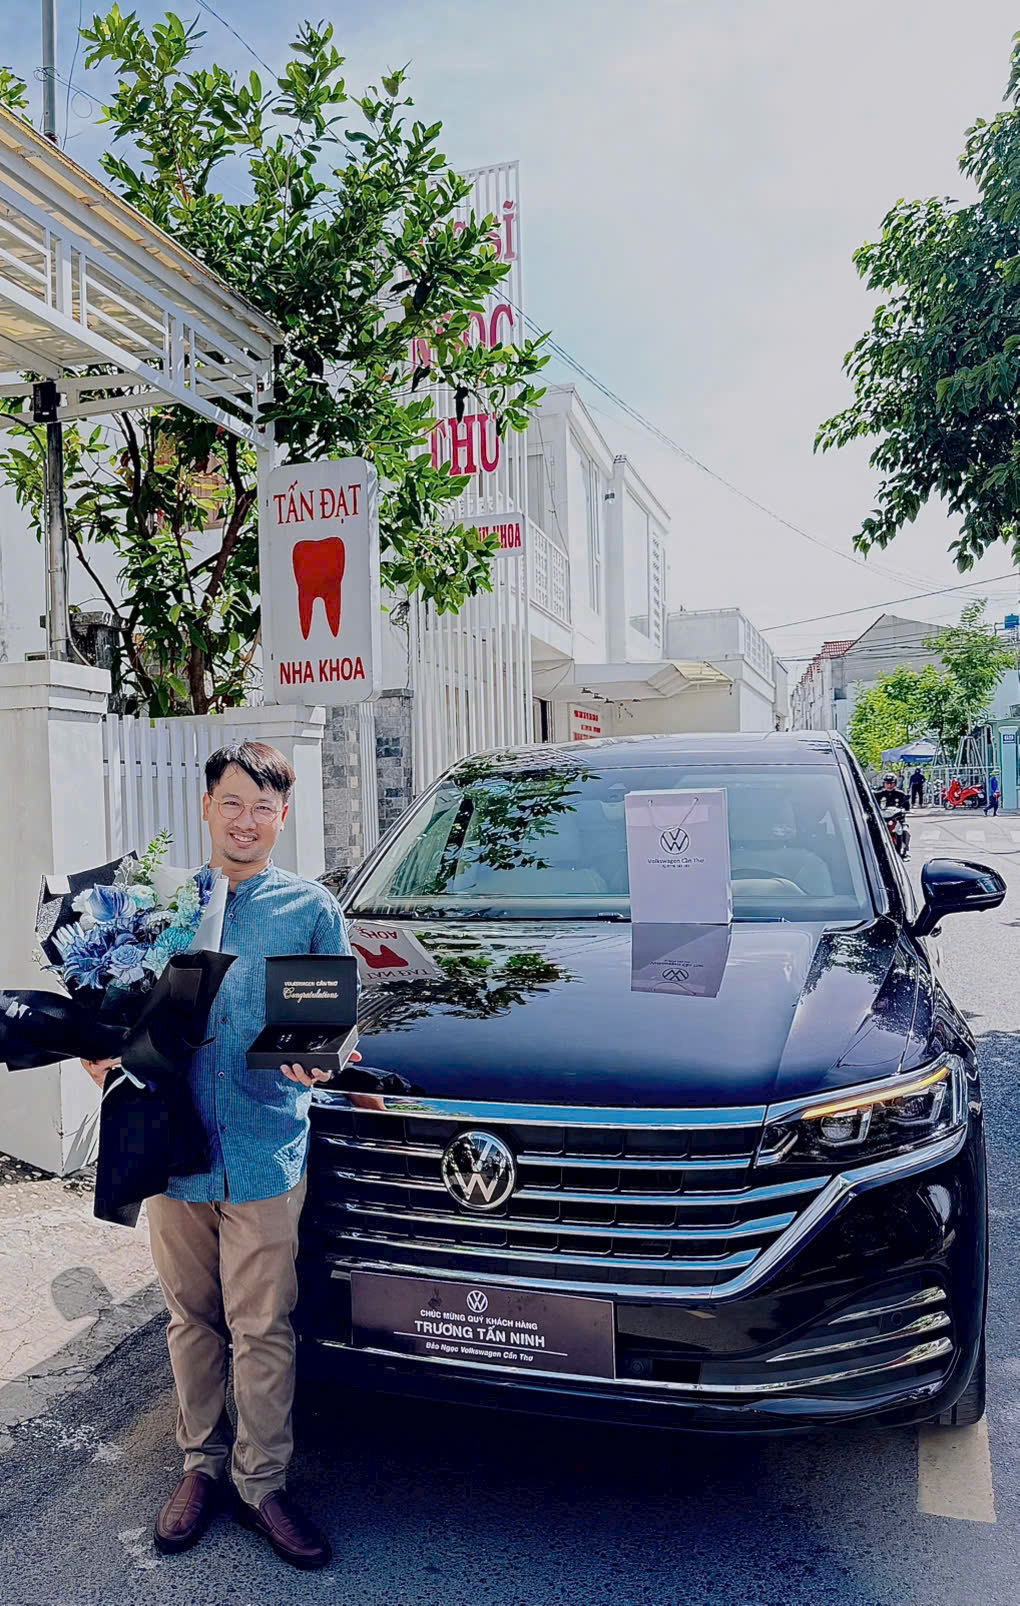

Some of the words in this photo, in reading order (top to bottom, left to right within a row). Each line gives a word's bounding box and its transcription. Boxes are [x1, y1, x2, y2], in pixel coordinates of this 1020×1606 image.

[273, 480, 314, 524] TẤN
[320, 484, 361, 524] ĐẠT
[279, 661, 315, 685] NHA
[318, 656, 366, 682] KHOA
[283, 986, 339, 1003] Congratulations
[414, 1319, 474, 1339] TRƯƠNG
[476, 1325, 507, 1343] TẤN
[510, 1331, 546, 1348] NINH
[485, 1316, 514, 1328] KHÁCH
[514, 1319, 538, 1330] HÀNG
[460, 1346, 502, 1358] Volkswagen
